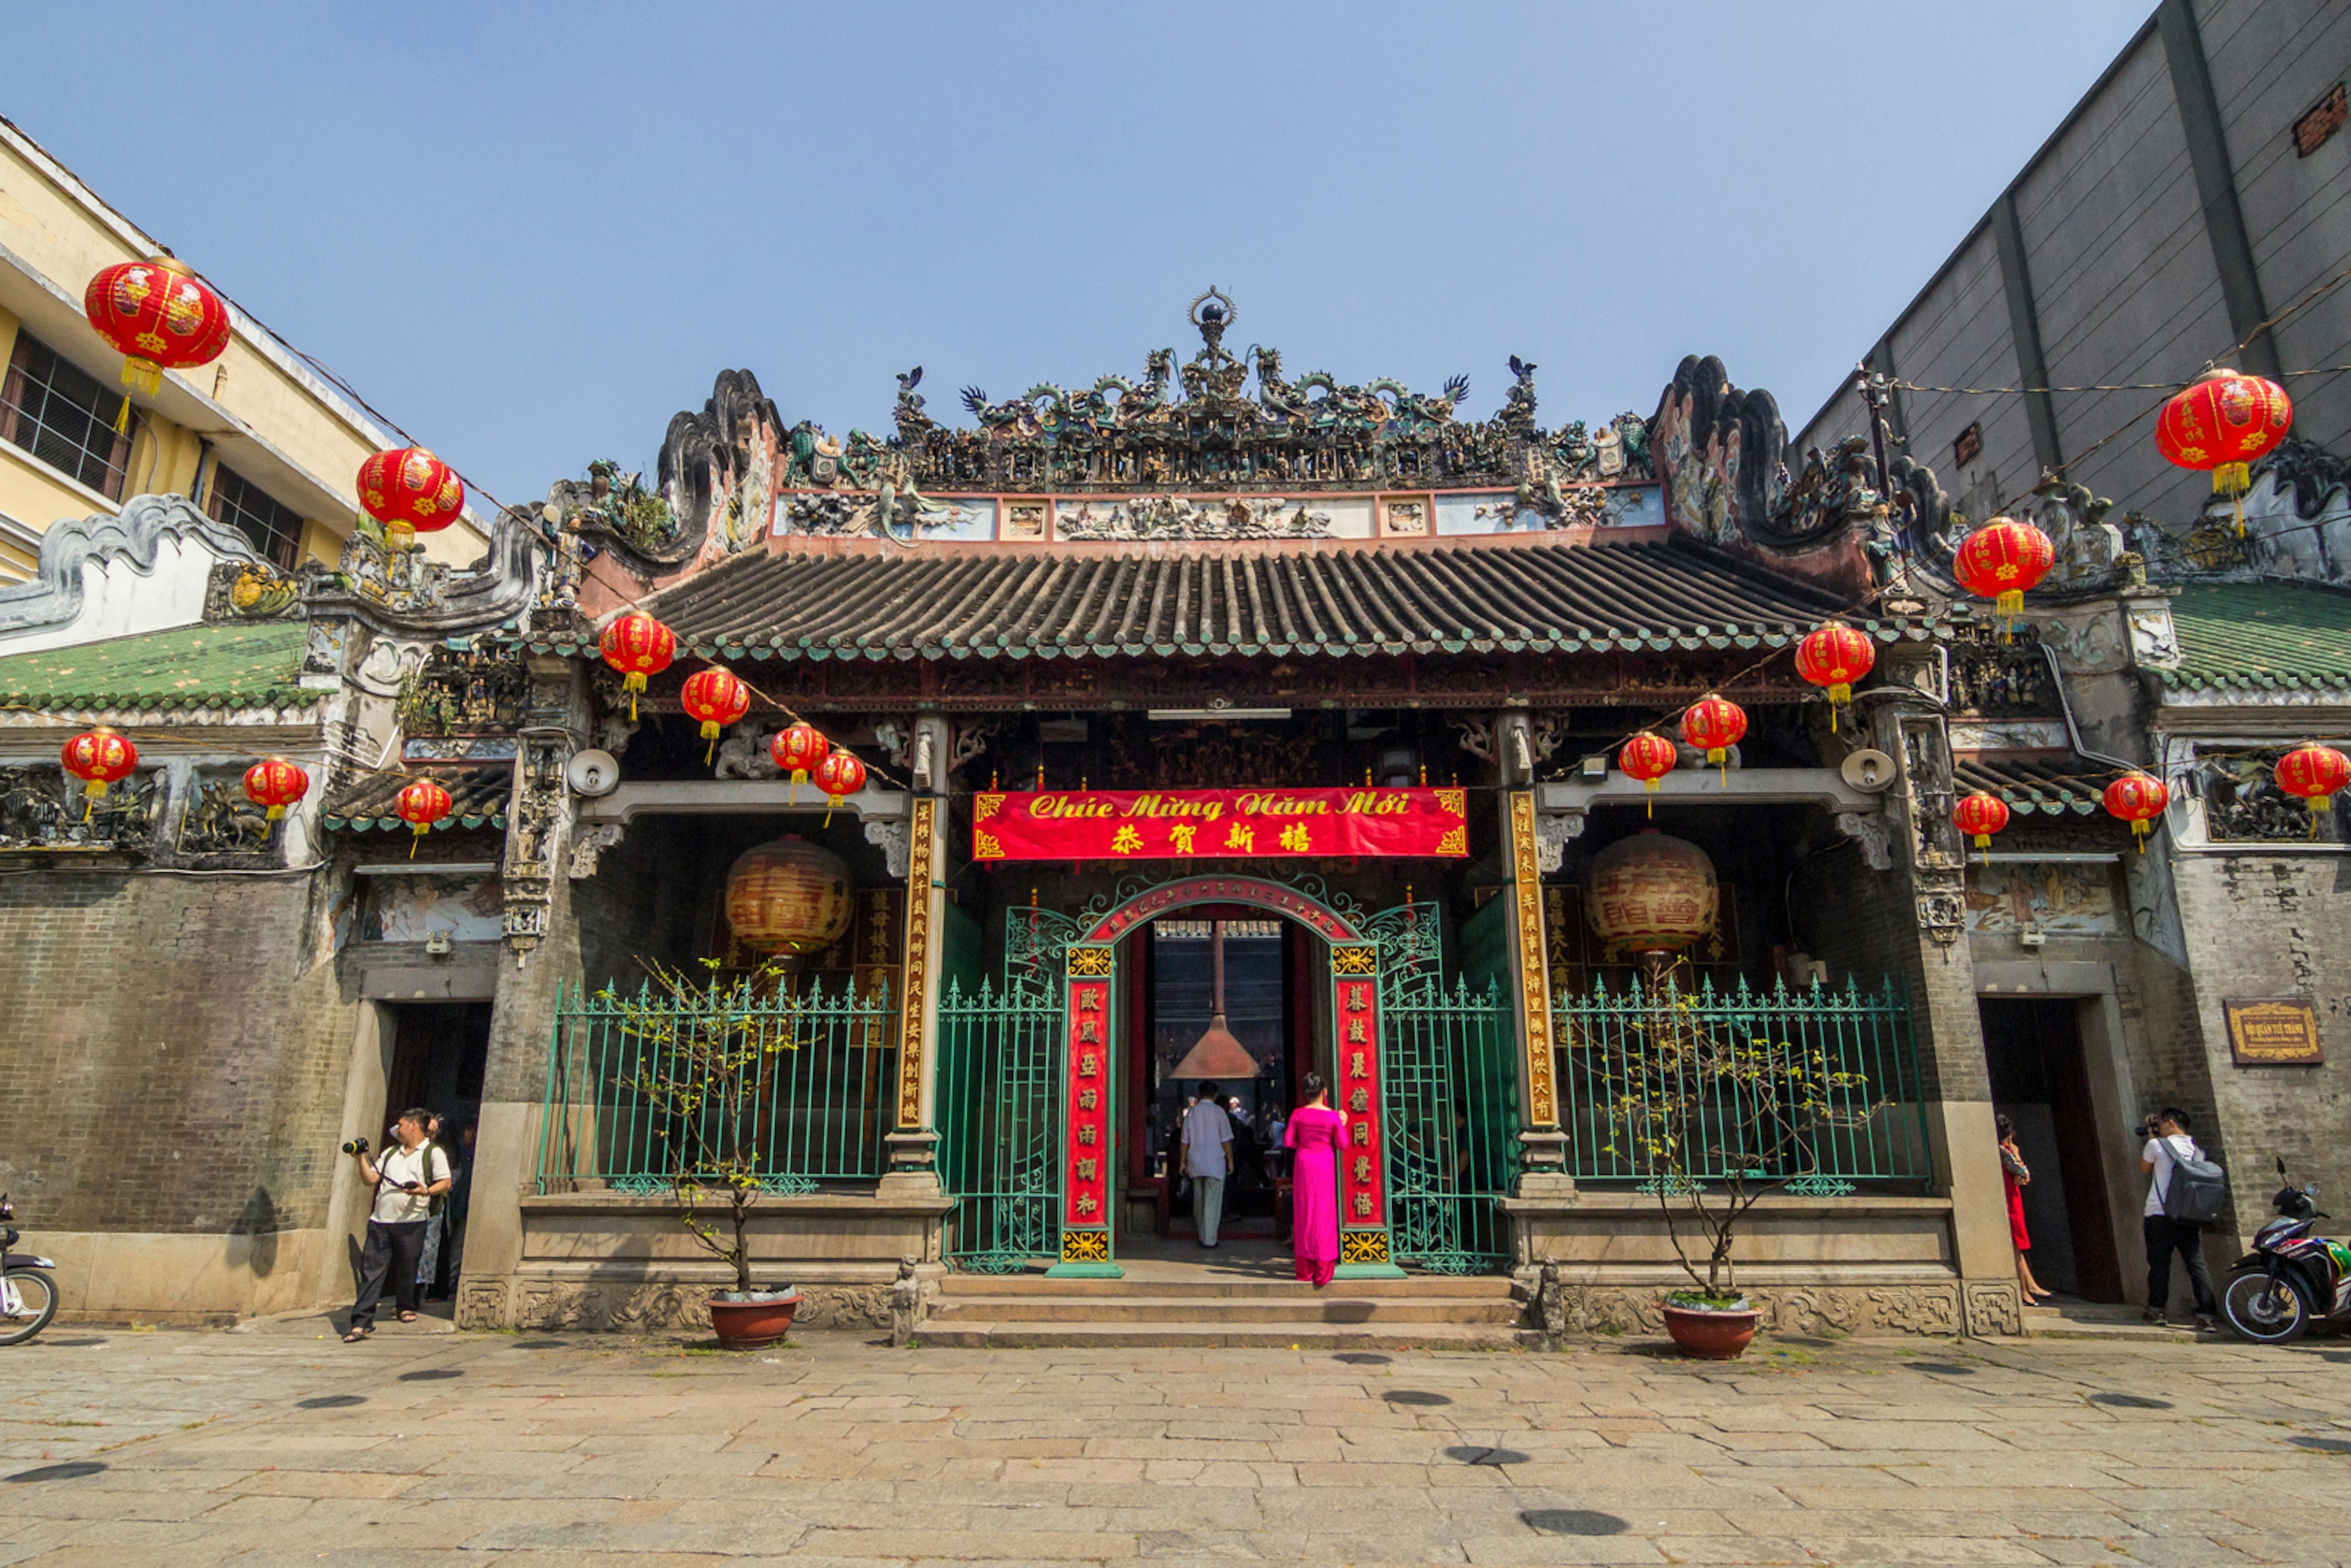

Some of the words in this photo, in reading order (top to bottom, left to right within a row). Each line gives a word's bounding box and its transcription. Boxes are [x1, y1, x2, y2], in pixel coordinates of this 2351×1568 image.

[1029, 795, 1114, 819] Chúc
[1119, 794, 1226, 822] Mừng
[1235, 792, 1331, 816] Năm
[1335, 791, 1411, 816] Mới
[1110, 822, 1313, 855] 恭賀新禧
